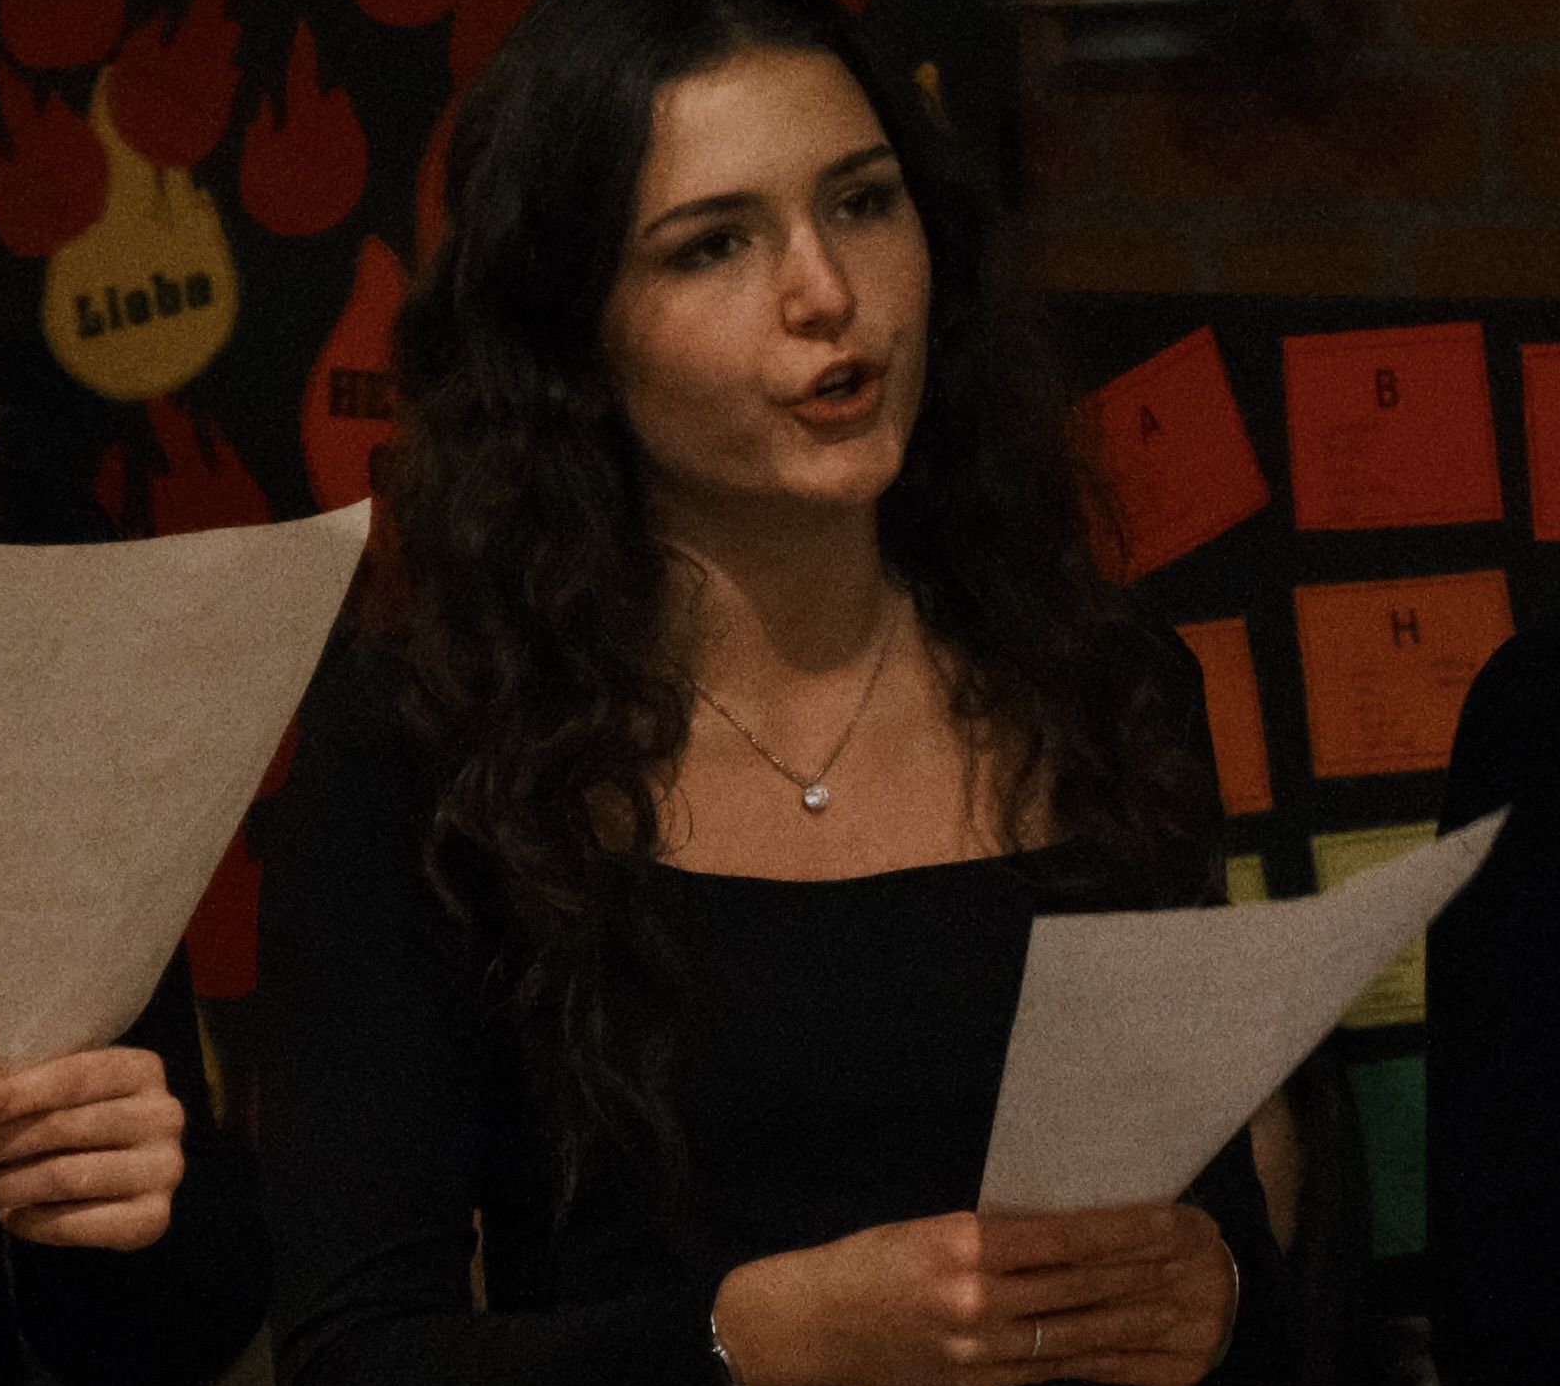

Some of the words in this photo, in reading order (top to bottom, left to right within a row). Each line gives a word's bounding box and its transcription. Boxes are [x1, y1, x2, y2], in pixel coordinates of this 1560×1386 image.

[75, 271, 212, 340] Liebe
[1375, 367, 1401, 410] B
[1139, 404, 1162, 443] A
[1389, 607, 1421, 649] H
